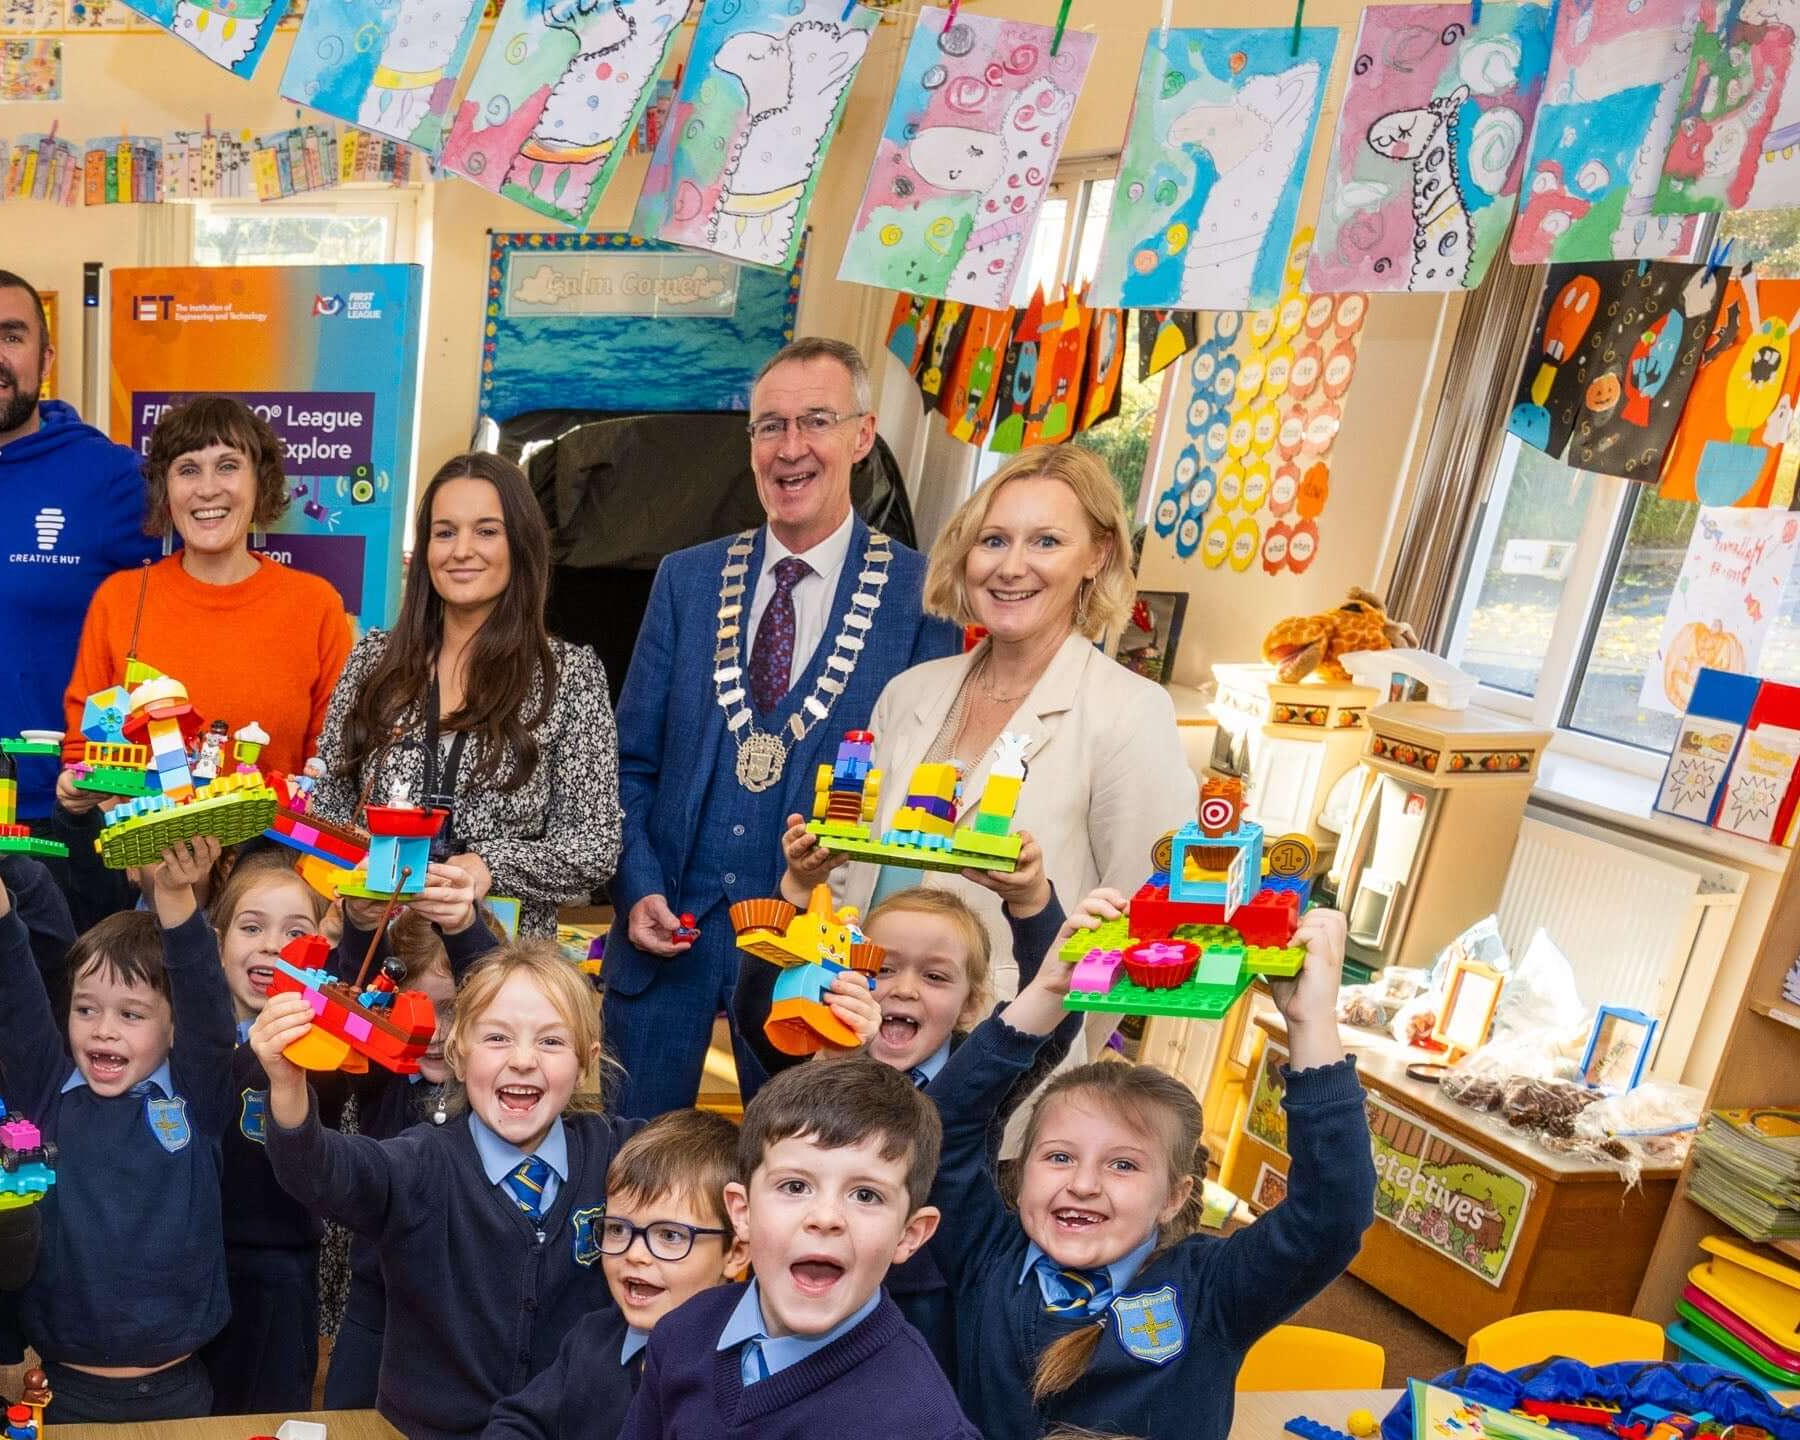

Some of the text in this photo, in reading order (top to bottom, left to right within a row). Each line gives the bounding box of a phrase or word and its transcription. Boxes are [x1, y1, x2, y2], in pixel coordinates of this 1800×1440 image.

[348, 291, 375, 301] FIRST
[133, 295, 175, 321] IET
[175, 304, 189, 312] The
[189, 304, 224, 313] Institution
[348, 301, 371, 310] LEGO
[175, 312, 214, 322] Engineering
[229, 312, 267, 322] Technology
[347, 310, 382, 319] LEAGUE
[287, 404, 363, 432] League
[9, 554, 80, 565] CREATIVE HUT
[1374, 1151, 1486, 1230] etectives
